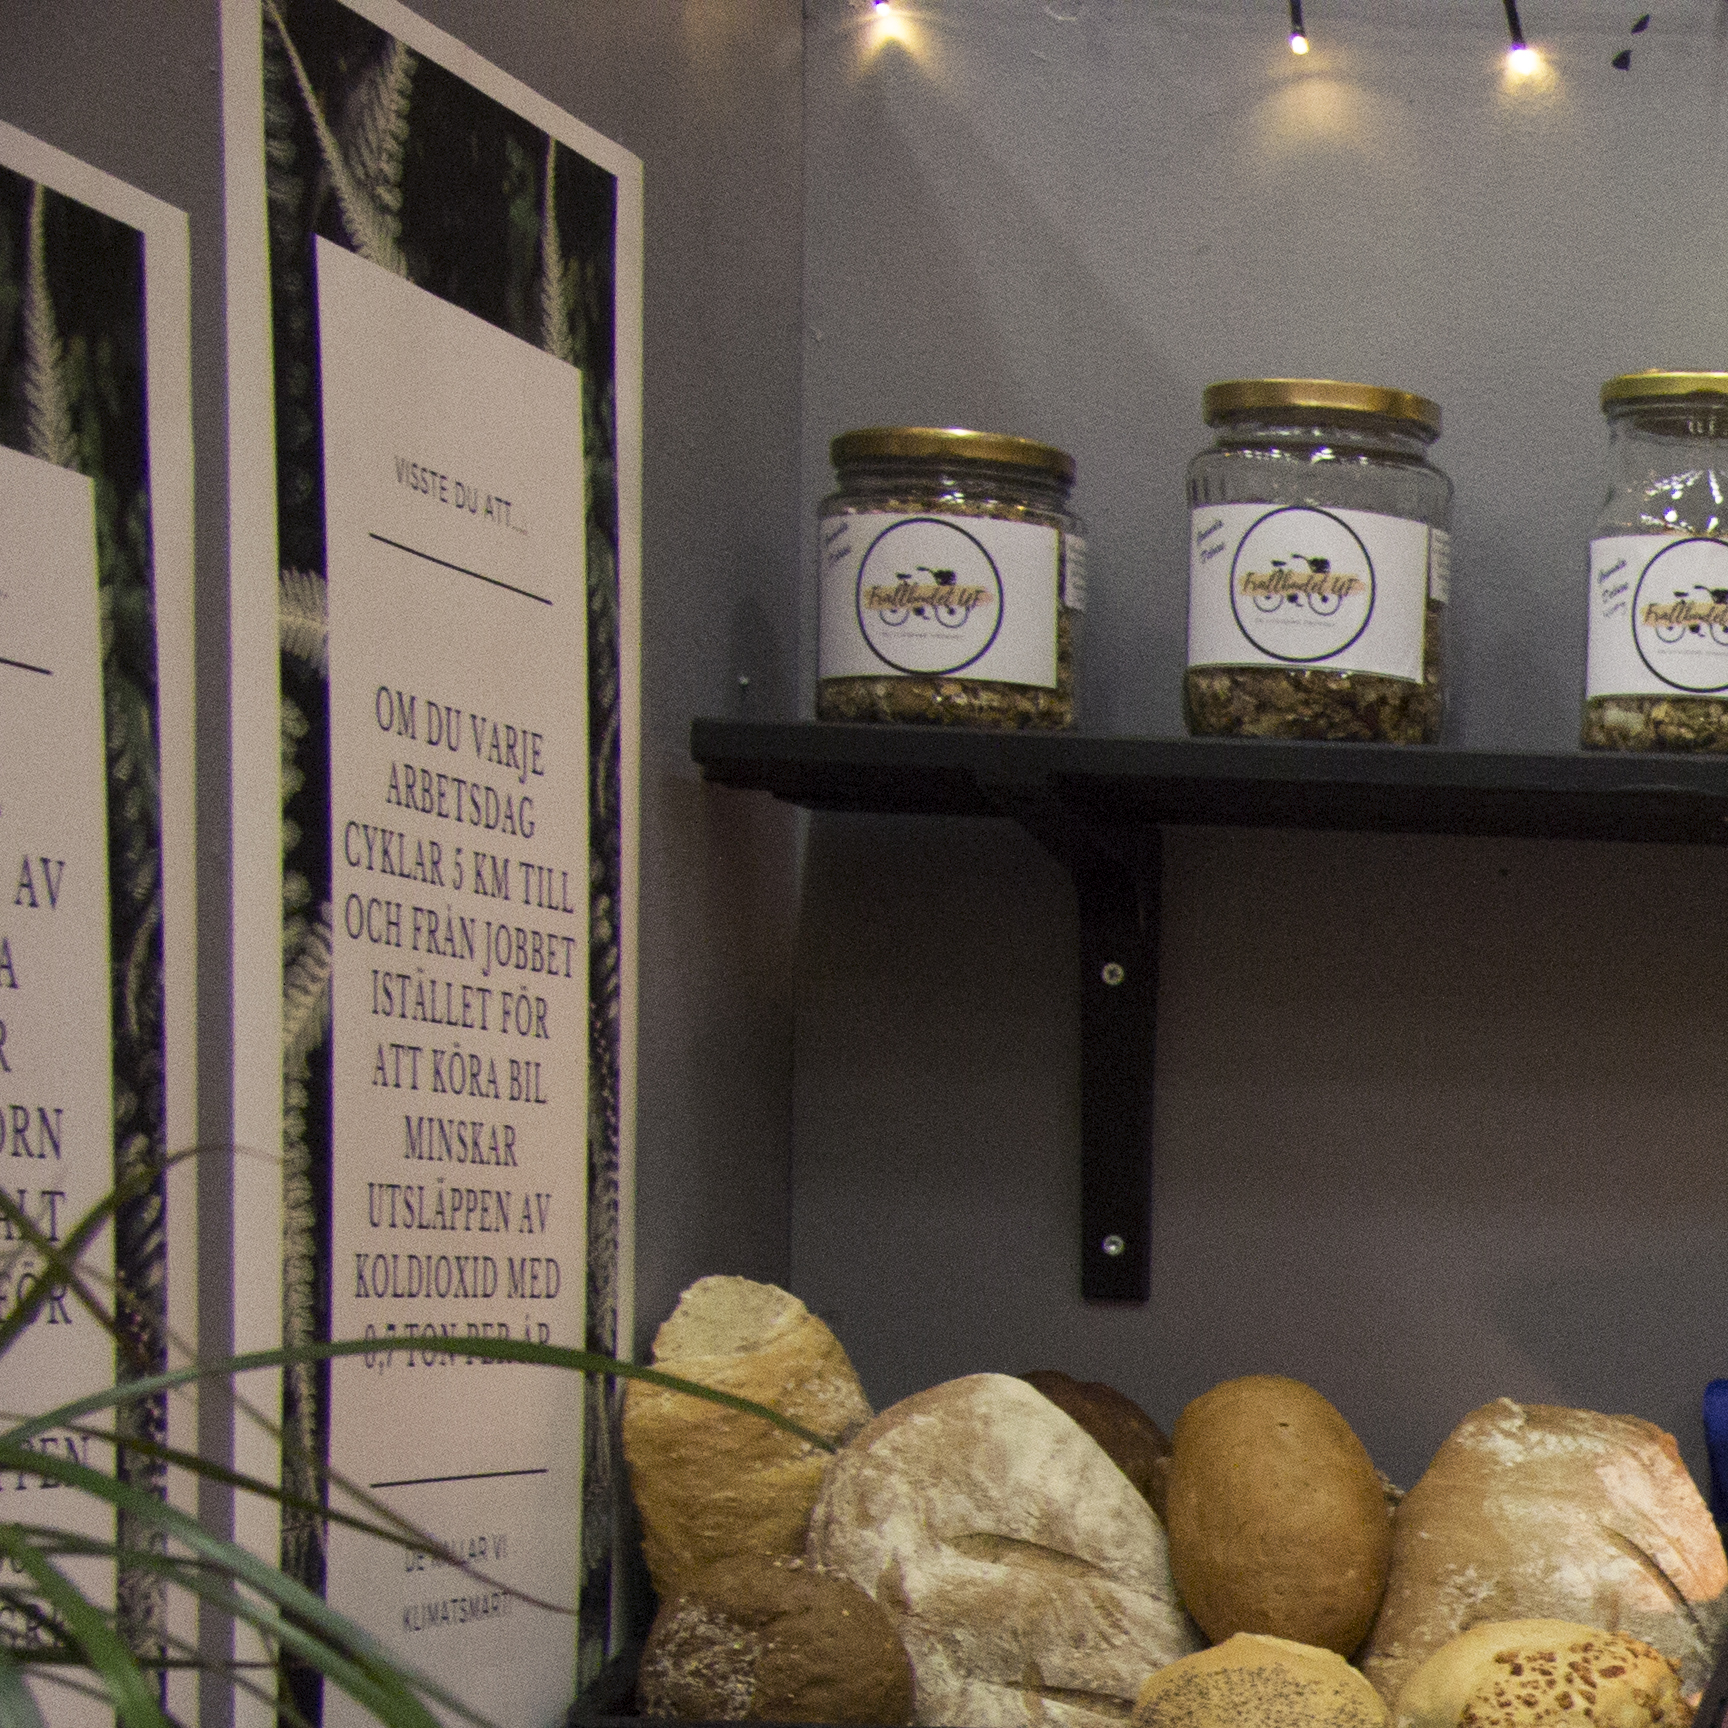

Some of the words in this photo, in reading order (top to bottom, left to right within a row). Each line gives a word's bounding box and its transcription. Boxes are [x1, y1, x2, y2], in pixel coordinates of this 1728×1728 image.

[394, 455, 448, 503] VISSTE
[455, 481, 477, 514] DU
[375, 685, 416, 740] OM
[426, 701, 461, 753] DU
[470, 711, 545, 784] VARJE
[386, 761, 536, 839] ARBETSDAG
[13, 854, 66, 911] AV
[344, 820, 444, 890] CYKLAR
[452, 847, 464, 890] 5
[473, 850, 510, 901] KM
[518, 861, 575, 914] TILL
[345, 893, 402, 950] OCH
[411, 900, 476, 961] FRÅN
[481, 917, 576, 979] JOBBET
[371, 966, 490, 1029] ISTÄLLET
[500, 985, 549, 1040] FÖR
[372, 1042, 423, 1092] ATT
[432, 1041, 500, 1100] KÖRA
[508, 1058, 547, 1104] BIL
[403, 1113, 518, 1168] MINSKAR
[367, 1177, 511, 1234] UTSLÄPPEN
[518, 1191, 552, 1235] AV
[354, 1251, 499, 1300] KOLDIOXID
[507, 1256, 562, 1301] MED
[403, 1590, 512, 1633] KLIMATSMART
